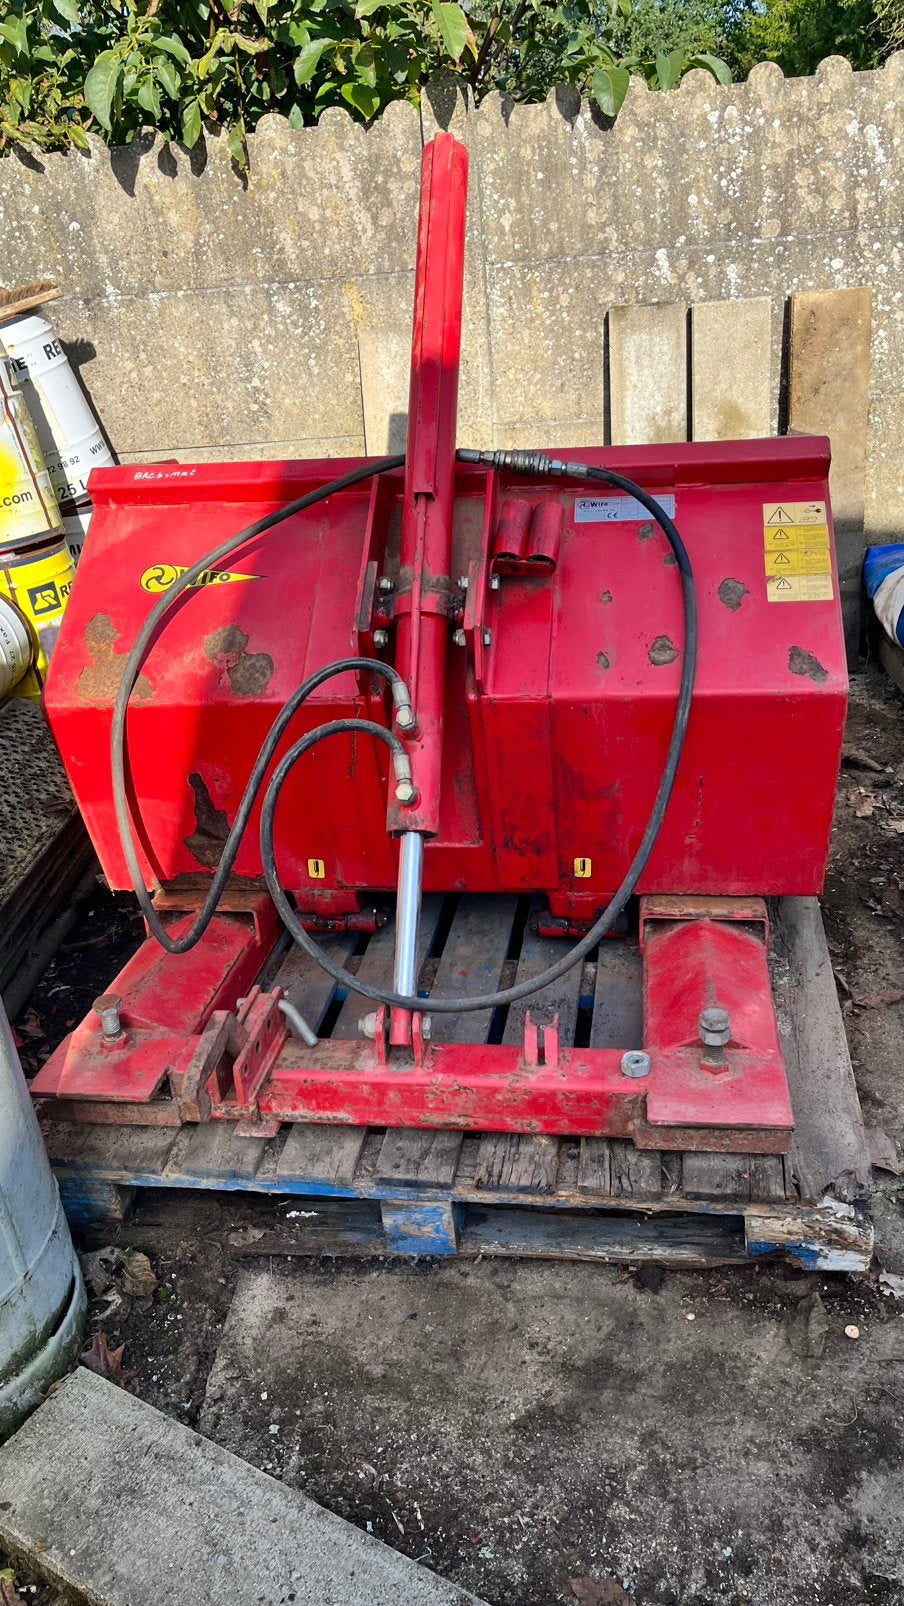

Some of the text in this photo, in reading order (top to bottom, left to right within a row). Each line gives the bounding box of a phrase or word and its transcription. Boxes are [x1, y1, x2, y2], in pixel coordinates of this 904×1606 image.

[58, 461, 68, 470] 98
[70, 456, 80, 465] 92
[58, 484, 77, 499] 25
